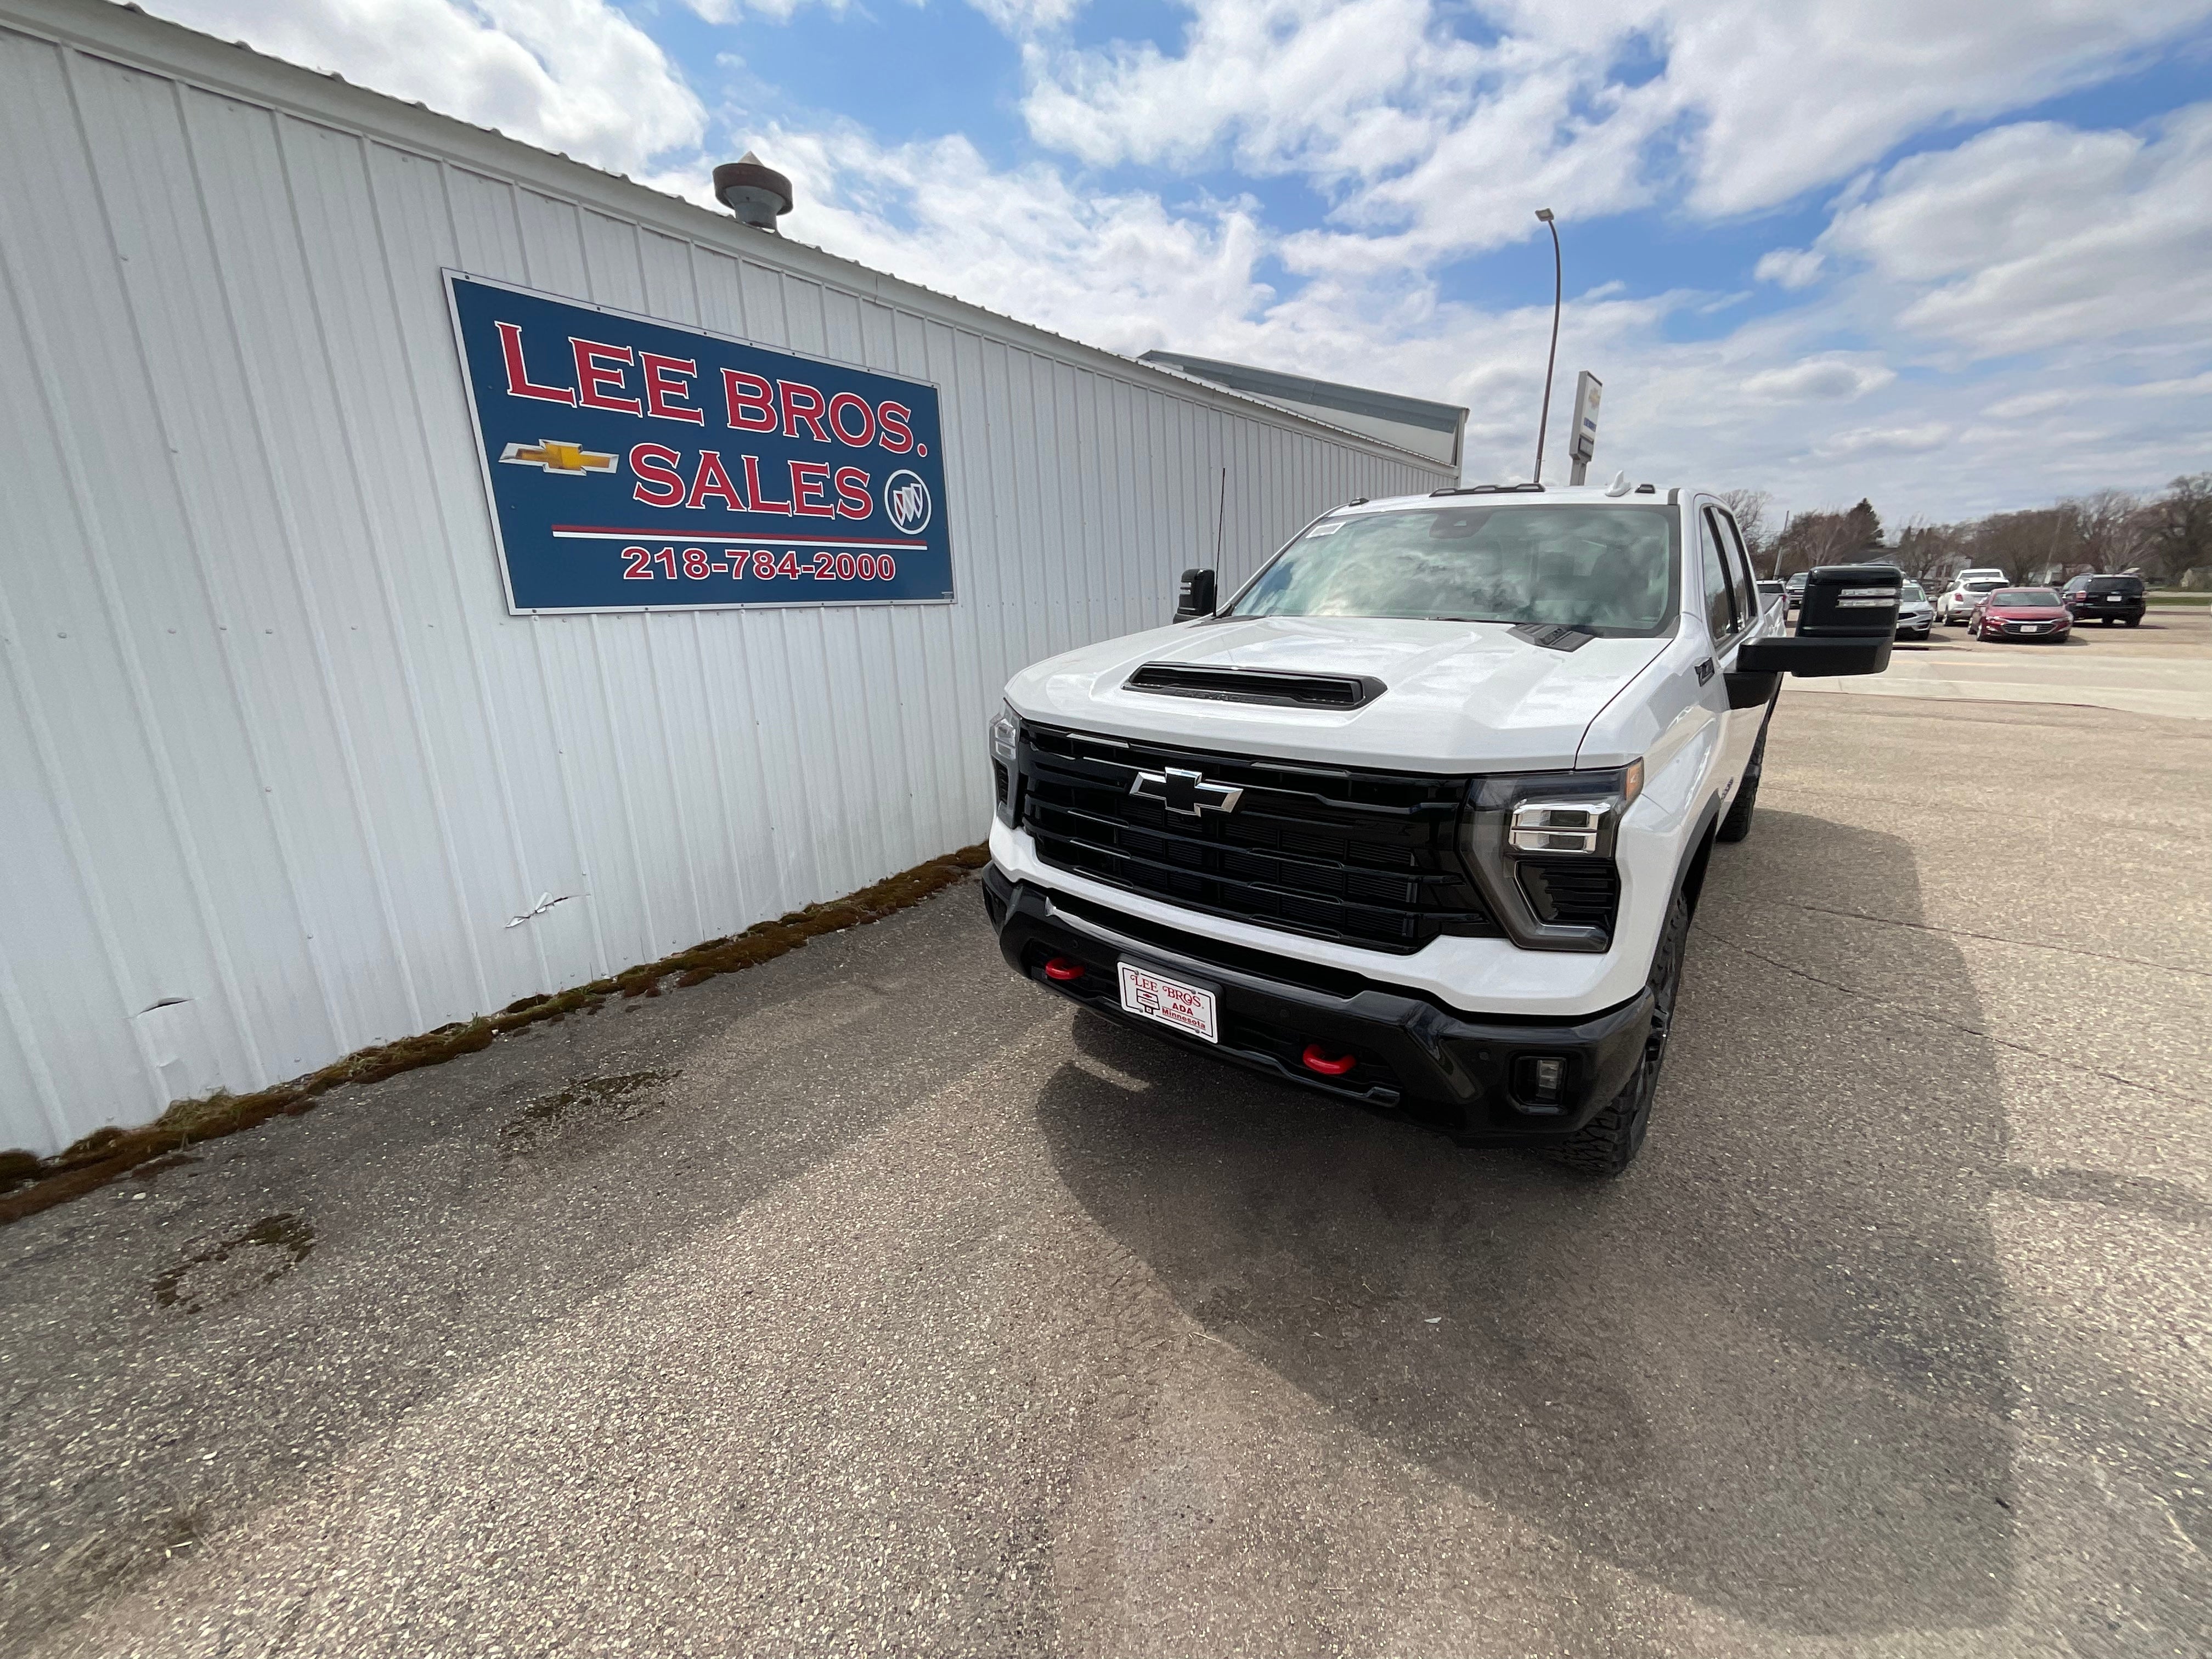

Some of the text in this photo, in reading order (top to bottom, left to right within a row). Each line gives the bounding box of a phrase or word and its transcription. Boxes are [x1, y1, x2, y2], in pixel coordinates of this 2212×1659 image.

[493, 319, 929, 459] LEE BROS.
[628, 441, 875, 521] SALES
[620, 546, 896, 582] 218-784-2000
[1174, 689, 1273, 704] CHEVROLE
[1130, 975, 1201, 1007] LEE BROS
[1162, 1007, 1205, 1029] Minnesota
[1172, 1003, 1193, 1015] ADA
